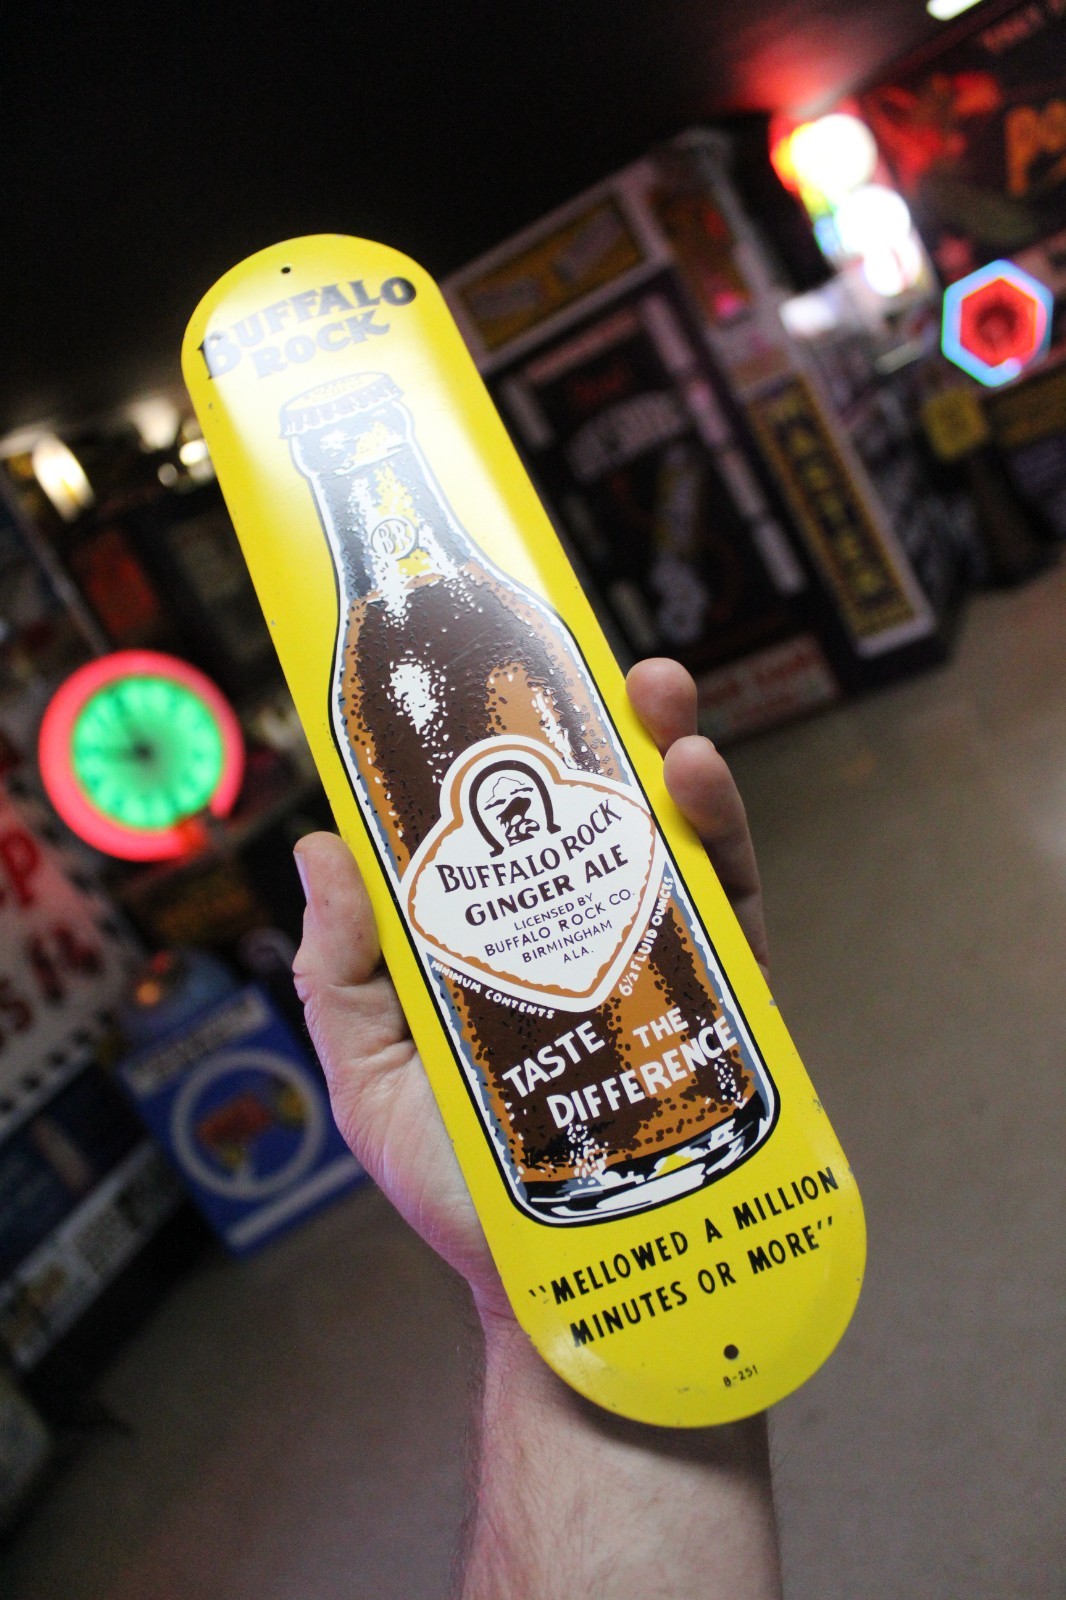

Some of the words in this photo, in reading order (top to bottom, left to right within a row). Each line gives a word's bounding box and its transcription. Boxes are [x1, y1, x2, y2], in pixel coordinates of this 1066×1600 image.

[197, 276, 416, 379] BUFFALO
[251, 309, 390, 379] ROCK
[435, 848, 560, 893] BUFFALO
[560, 799, 622, 860] ROCK
[465, 874, 575, 926] GINGER
[584, 844, 628, 883] ALE
[483, 926, 551, 957] BUFFALO
[558, 902, 606, 932] ROCK
[608, 888, 635, 906] CO.
[513, 903, 574, 930] LICENSED
[577, 893, 593, 909] BY
[522, 919, 613, 963] BIRMINGHAM
[630, 929, 658, 971] FLUID
[651, 876, 674, 926] OUNCES
[431, 960, 481, 993] MINIMUM
[485, 990, 555, 1019] CONTENTS
[562, 950, 594, 963] ALA.
[502, 1021, 606, 1098] TASTE
[632, 1007, 689, 1048] THE
[547, 1016, 738, 1129] DIFFERENCE
[705, 1218, 723, 1243] A
[733, 1167, 839, 1230] MILLION
[569, 1281, 688, 1348] MINUTES
[698, 1262, 736, 1294] OR
